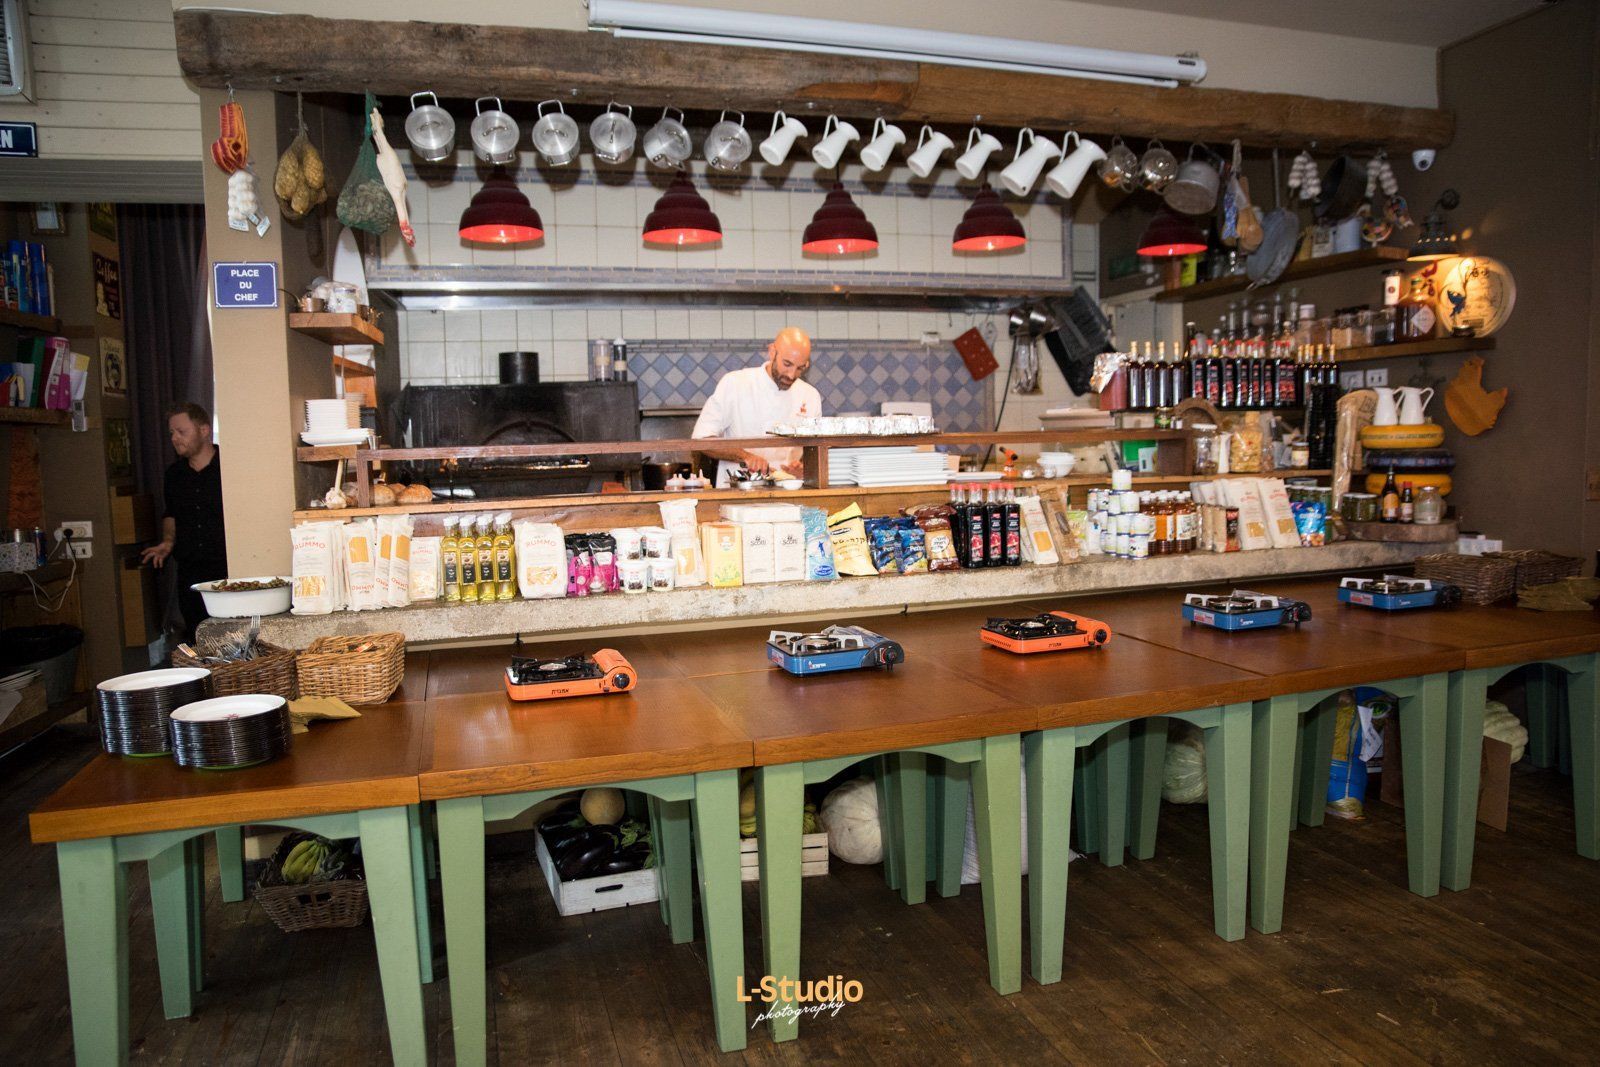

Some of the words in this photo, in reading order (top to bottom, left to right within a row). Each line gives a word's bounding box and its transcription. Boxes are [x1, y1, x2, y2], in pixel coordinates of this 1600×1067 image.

[0, 130, 13, 148] N
[230, 269, 260, 277] PLACE
[239, 281, 252, 289] DU
[234, 293, 259, 301] CHEF
[294, 540, 326, 550] RUMMO
